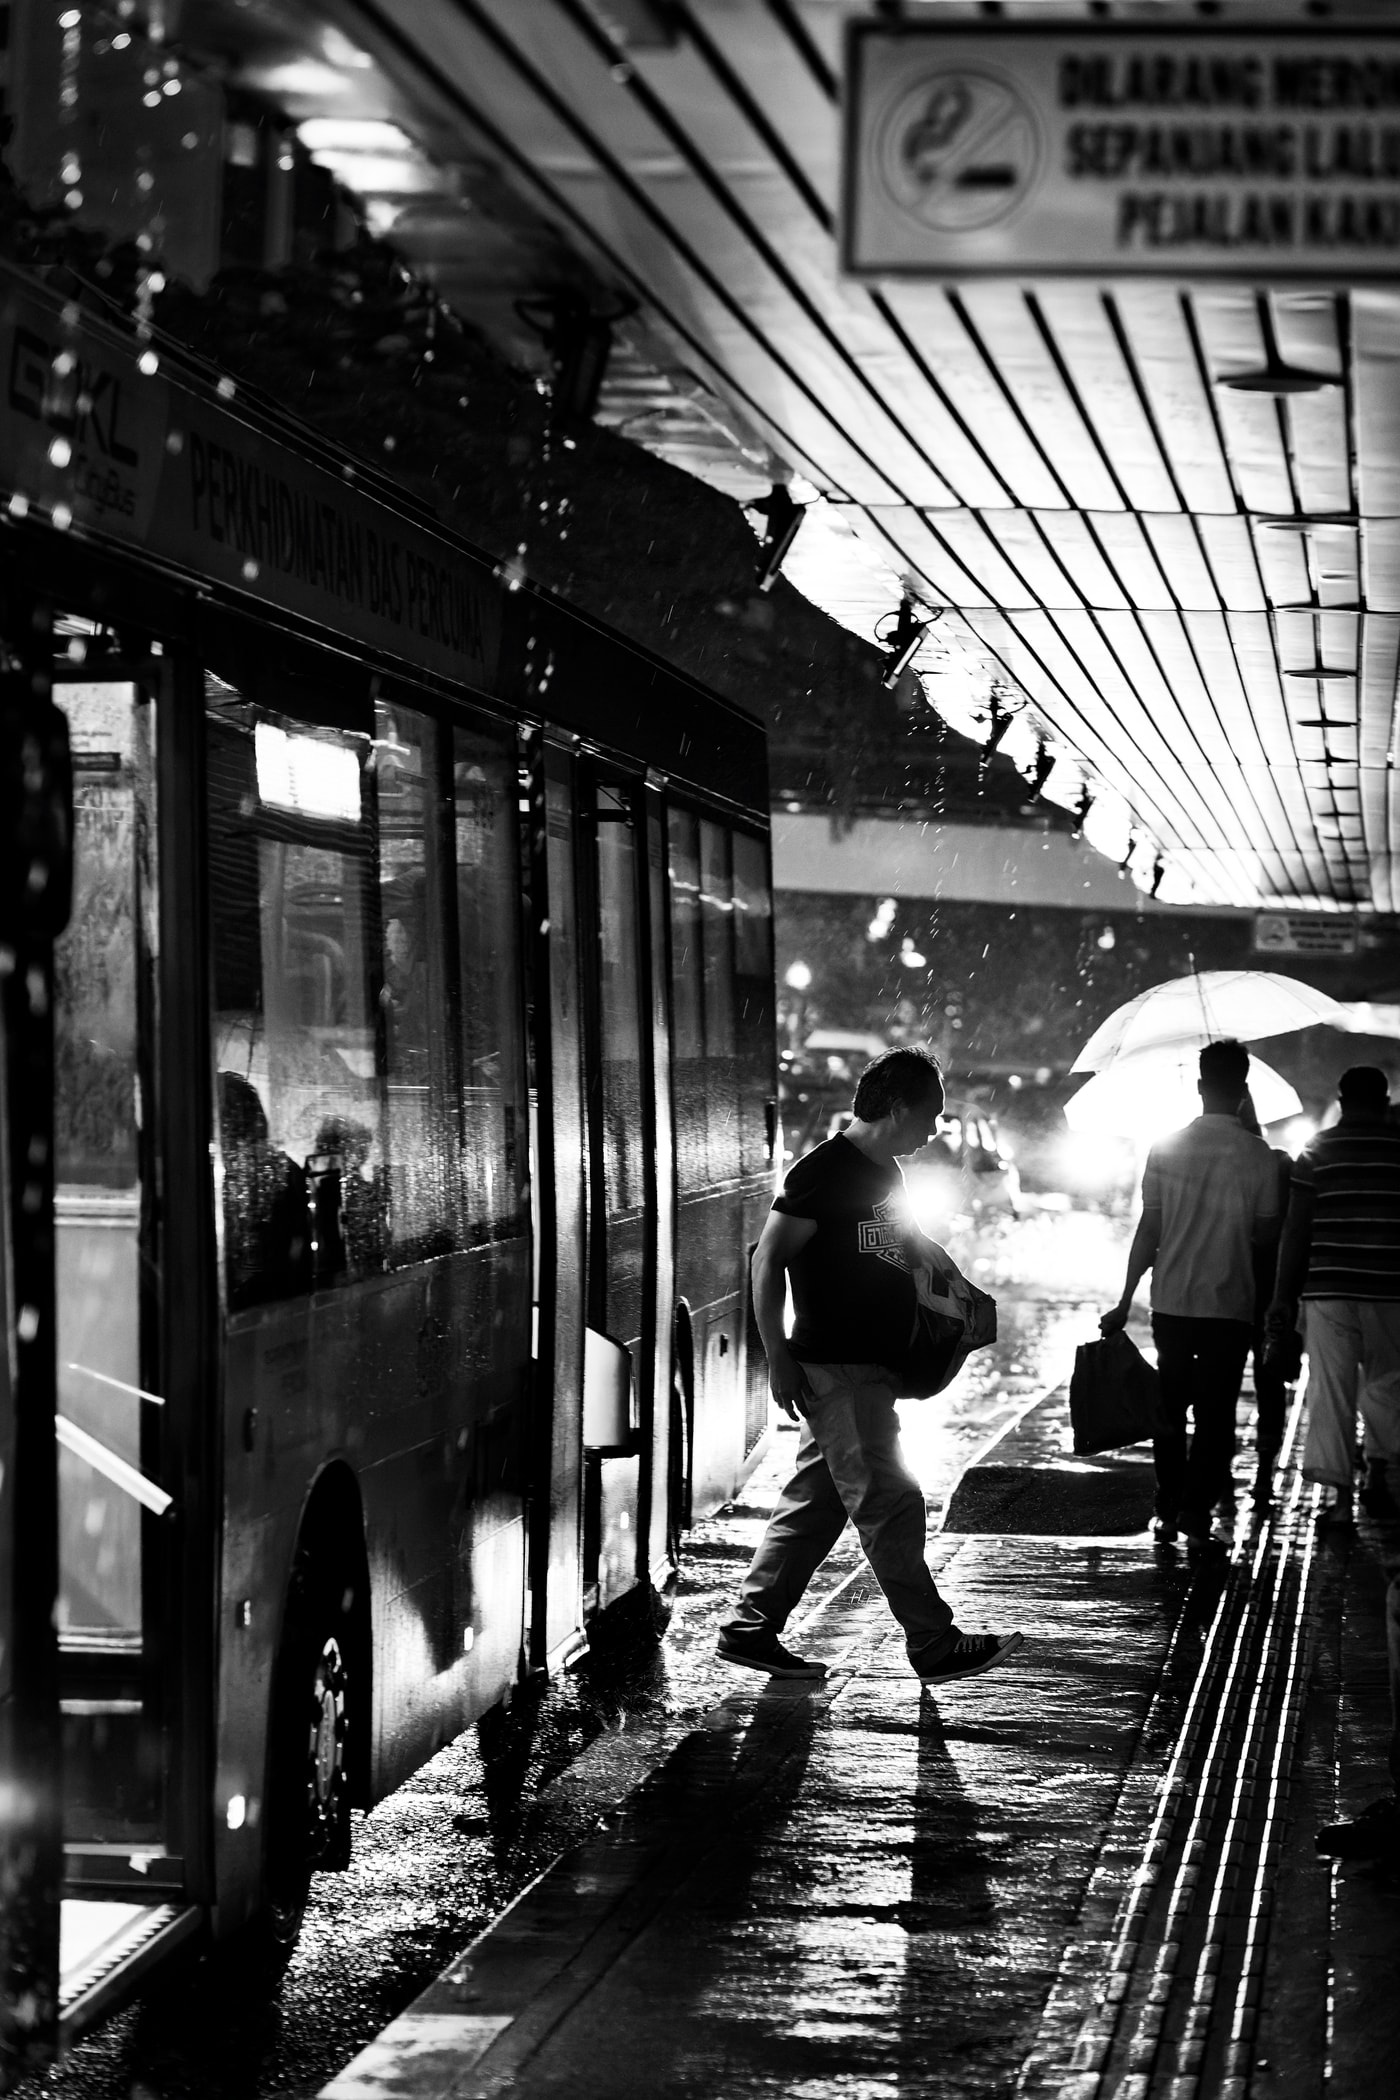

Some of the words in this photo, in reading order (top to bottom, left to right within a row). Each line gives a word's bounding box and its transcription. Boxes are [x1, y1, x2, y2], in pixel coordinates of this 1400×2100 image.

[1057, 53, 1265, 110] DILARANG
[1065, 123, 1295, 180] SEPANJANG
[1116, 193, 1294, 248] PEJALAN
[366, 528, 402, 625] BAS
